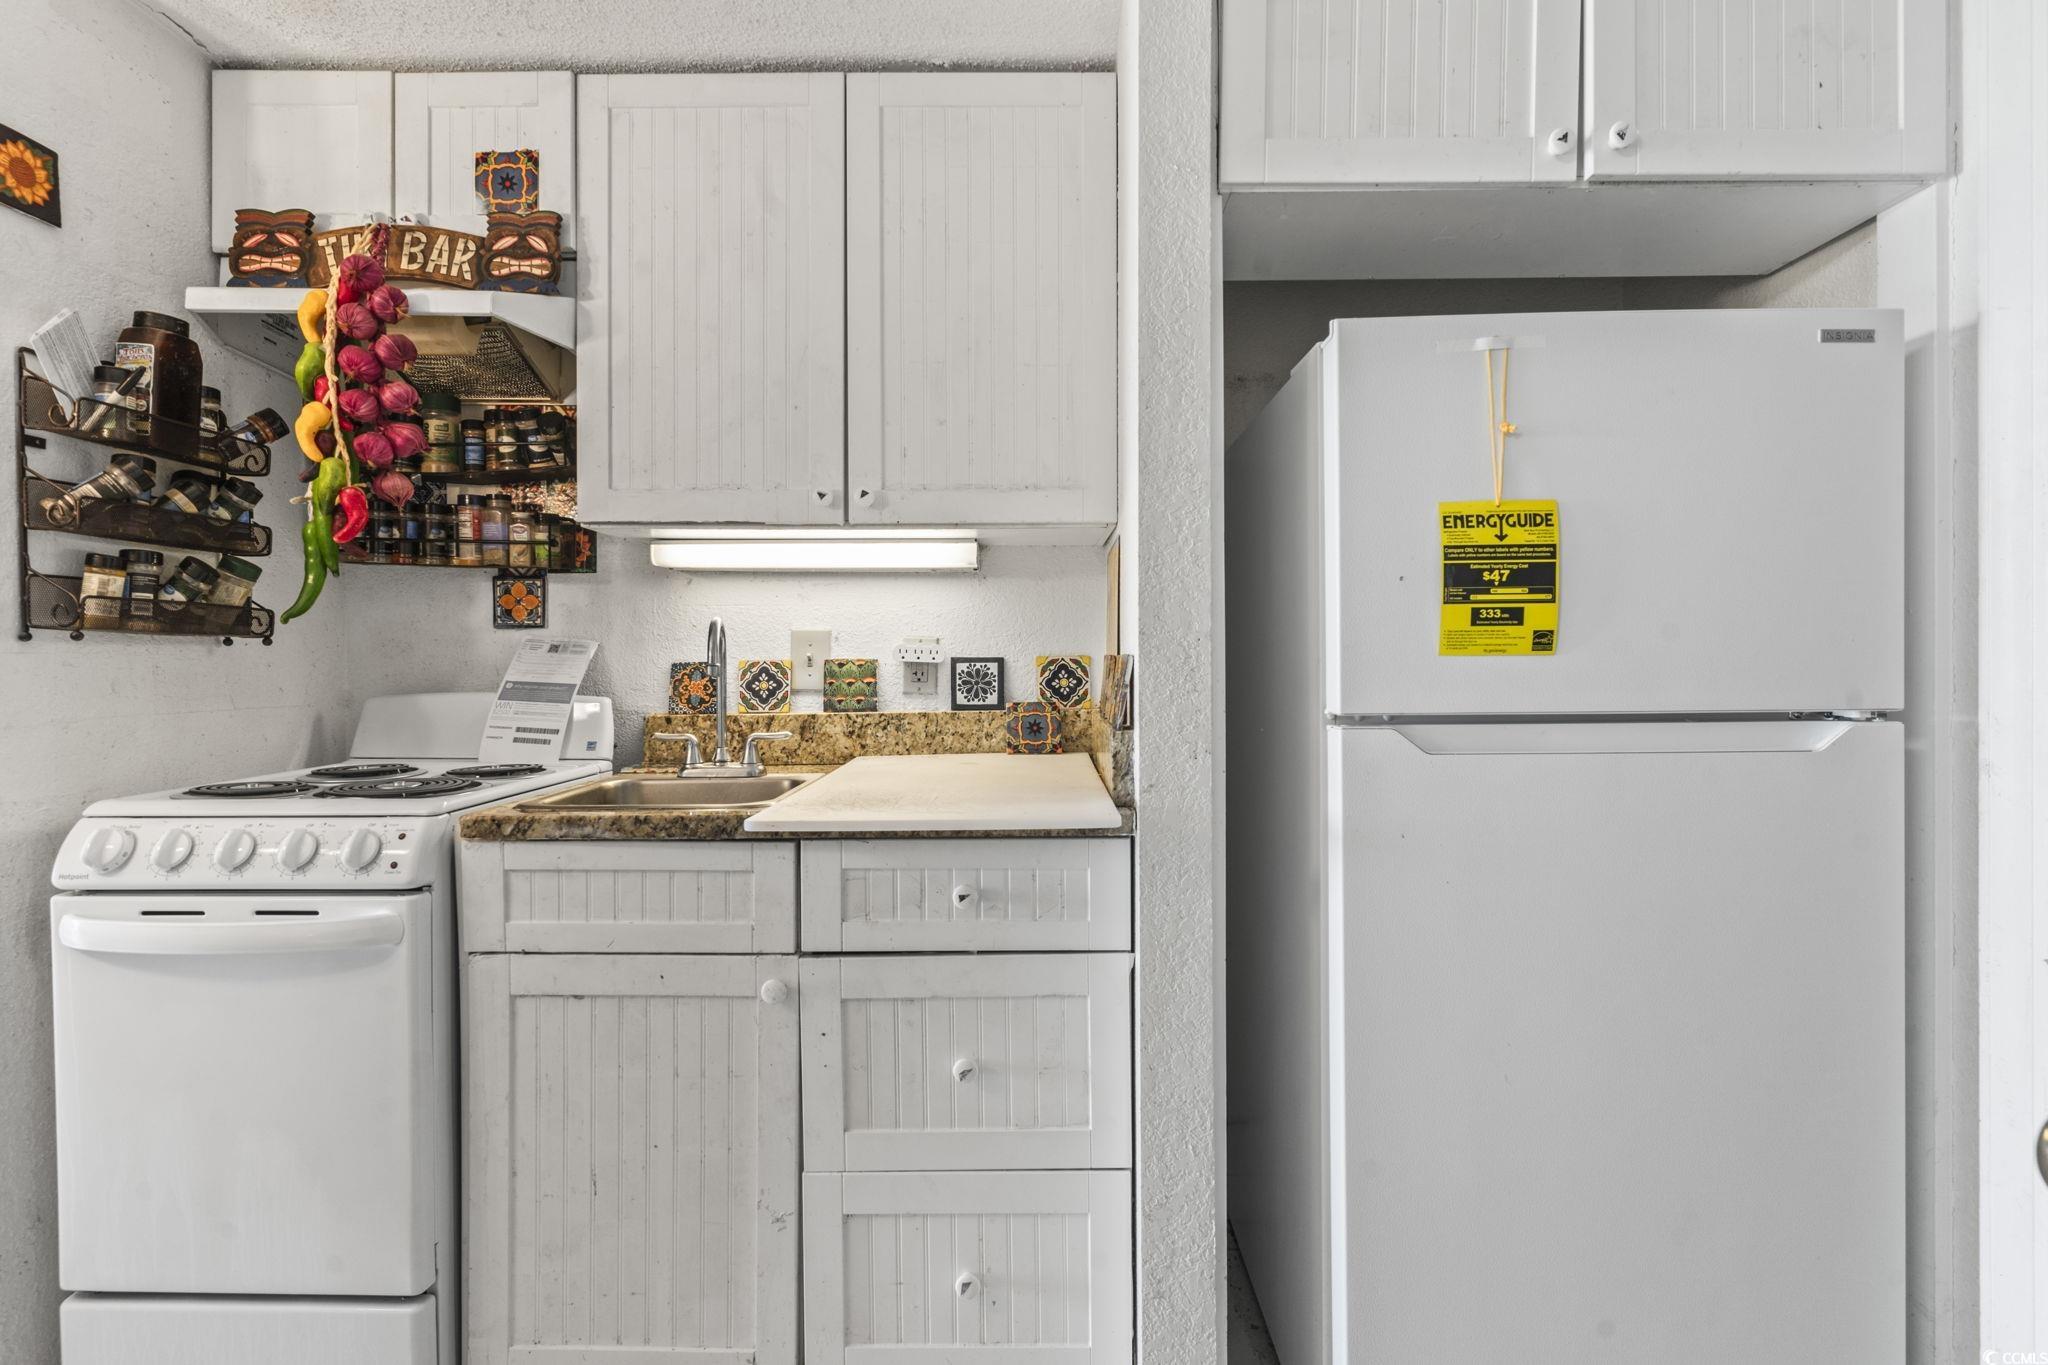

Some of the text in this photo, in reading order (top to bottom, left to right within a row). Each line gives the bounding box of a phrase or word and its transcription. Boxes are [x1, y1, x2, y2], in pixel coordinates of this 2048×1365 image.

[317, 230, 477, 281] TI BAR
[1822, 331, 1874, 340] INSIGNIA
[1442, 512, 1555, 529] ENERGYGUIDE
[1482, 569, 1510, 582] $47
[1479, 609, 1501, 618] 333
